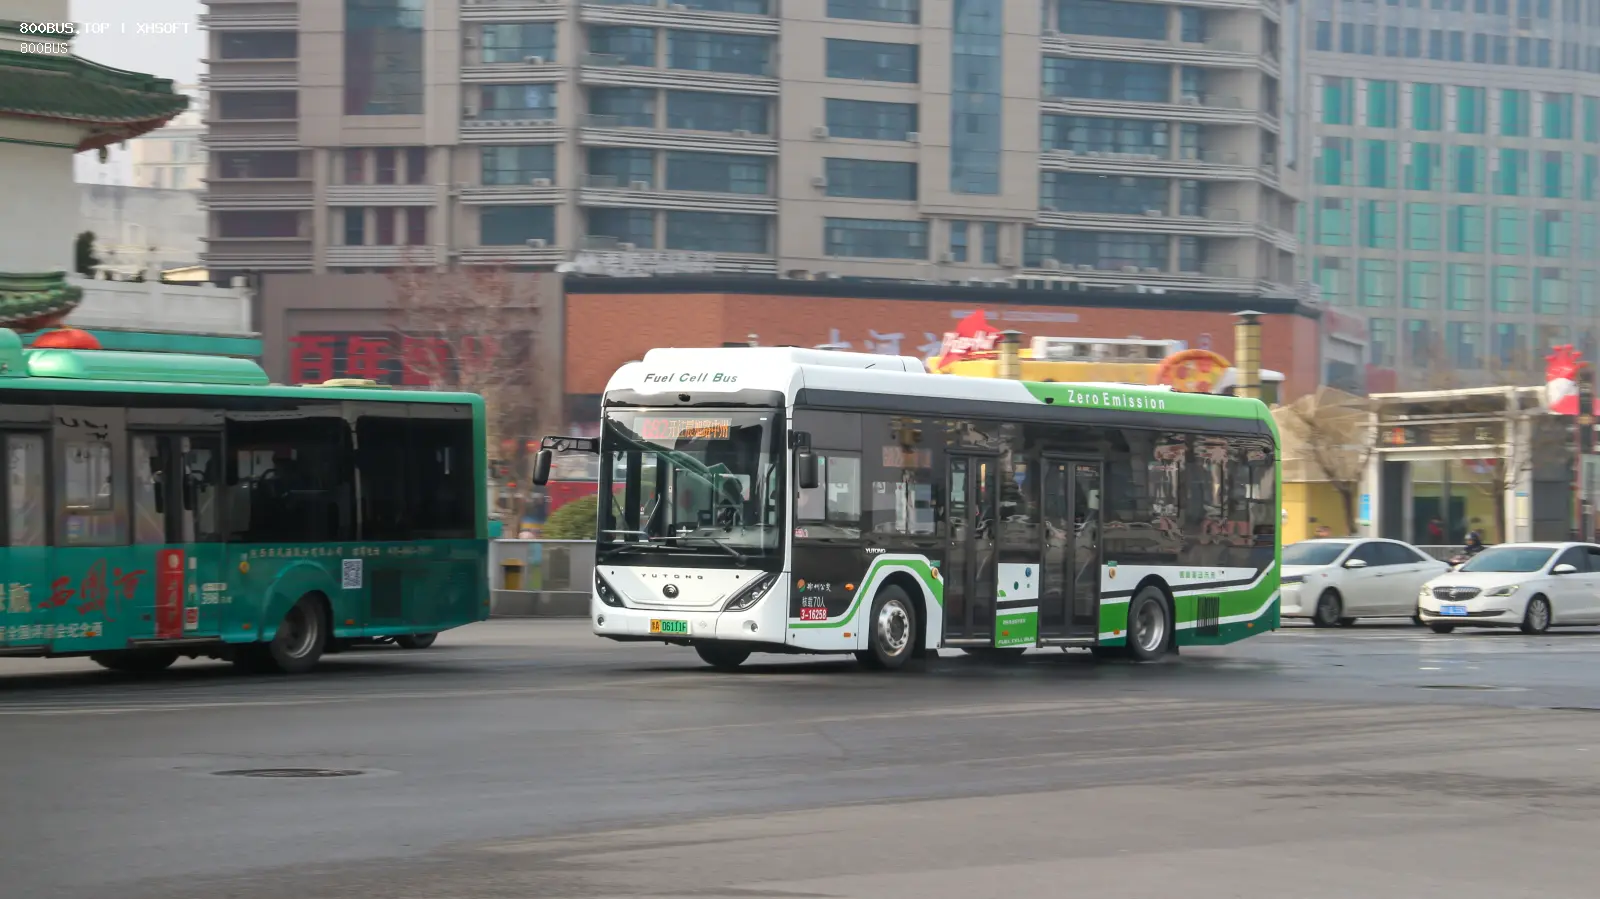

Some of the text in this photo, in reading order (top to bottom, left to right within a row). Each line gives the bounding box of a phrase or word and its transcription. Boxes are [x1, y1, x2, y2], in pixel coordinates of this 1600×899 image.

[644, 373, 738, 383] Fuel Cell Bus
[1067, 389, 1165, 410] Zero Emission
[865, 547, 886, 555] YUTONG
[801, 609, 827, 619] 3-16258
